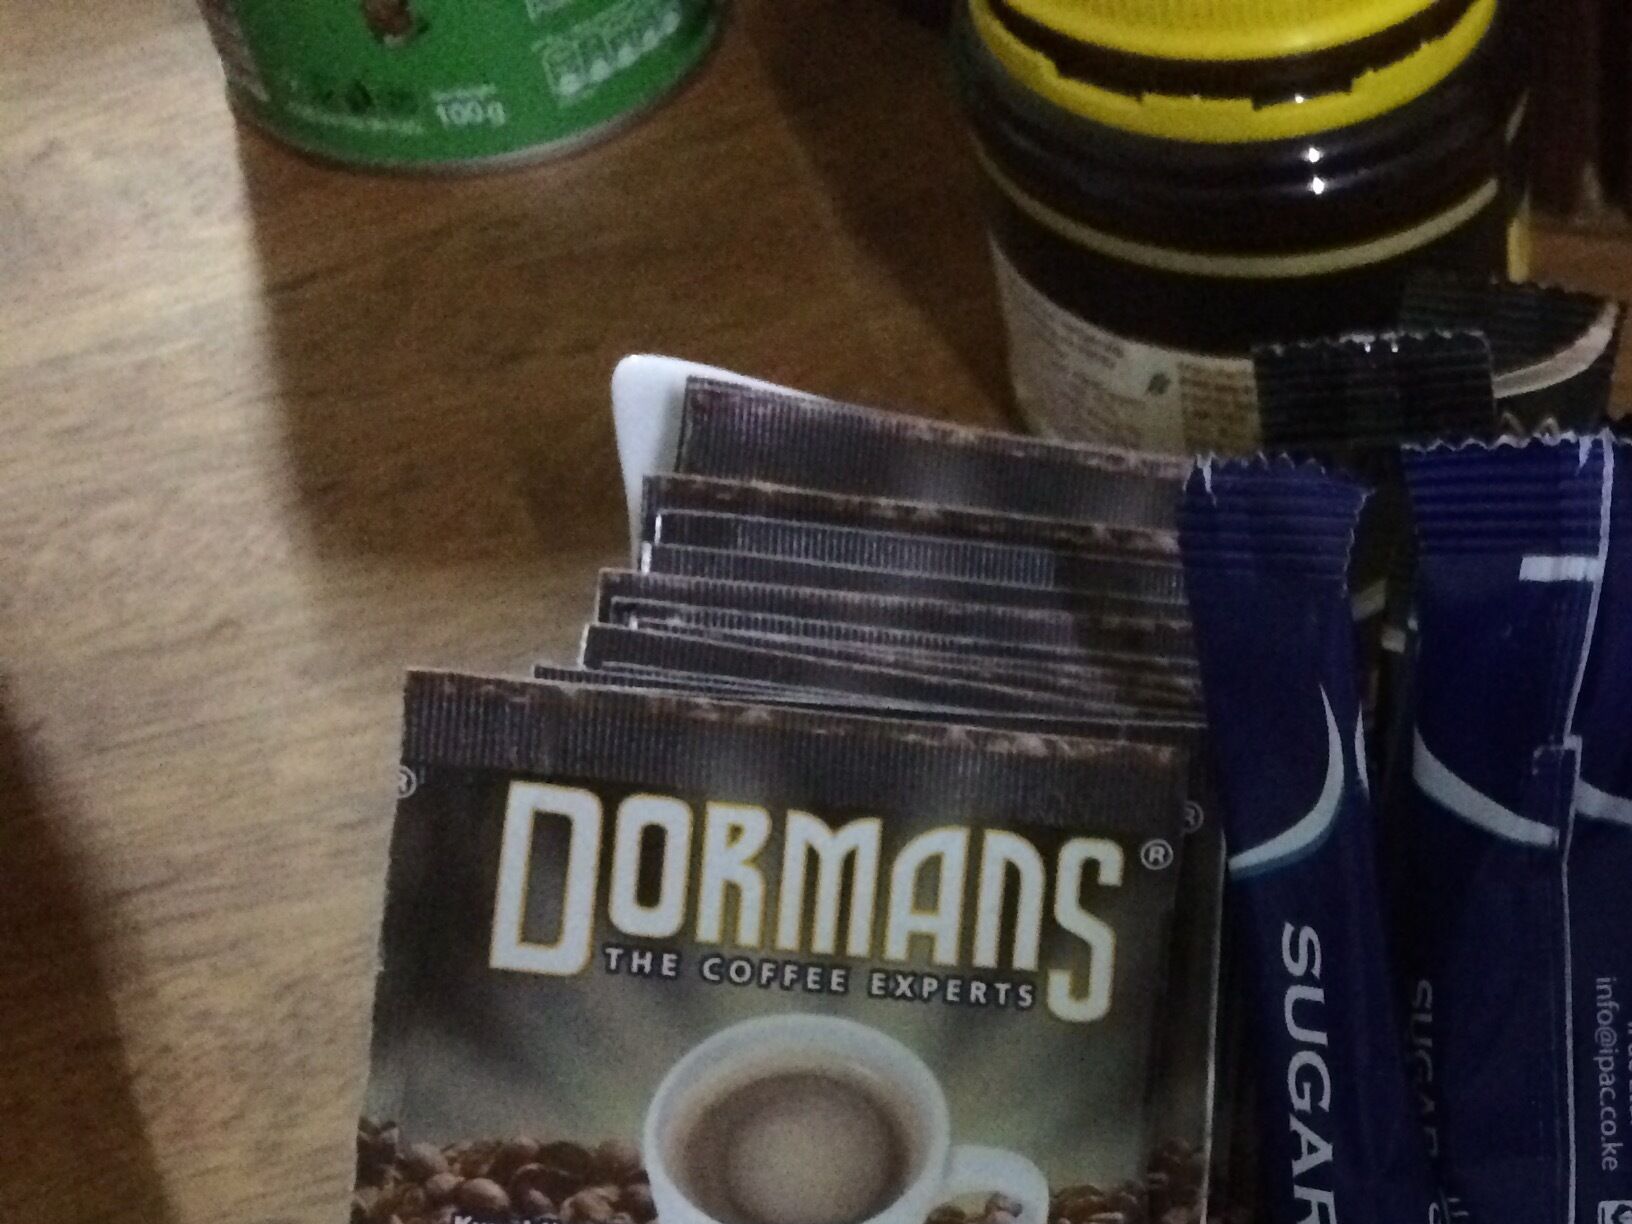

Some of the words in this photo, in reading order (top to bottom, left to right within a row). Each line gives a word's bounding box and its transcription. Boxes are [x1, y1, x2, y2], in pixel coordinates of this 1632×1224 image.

[489, 778, 1125, 1024] DORMANS
[604, 946, 679, 979] THE
[701, 955, 849, 995] COFFEE
[870, 970, 1038, 1011] EXPERTS
[1593, 975, 1624, 1172] info@ipac.co.ke
